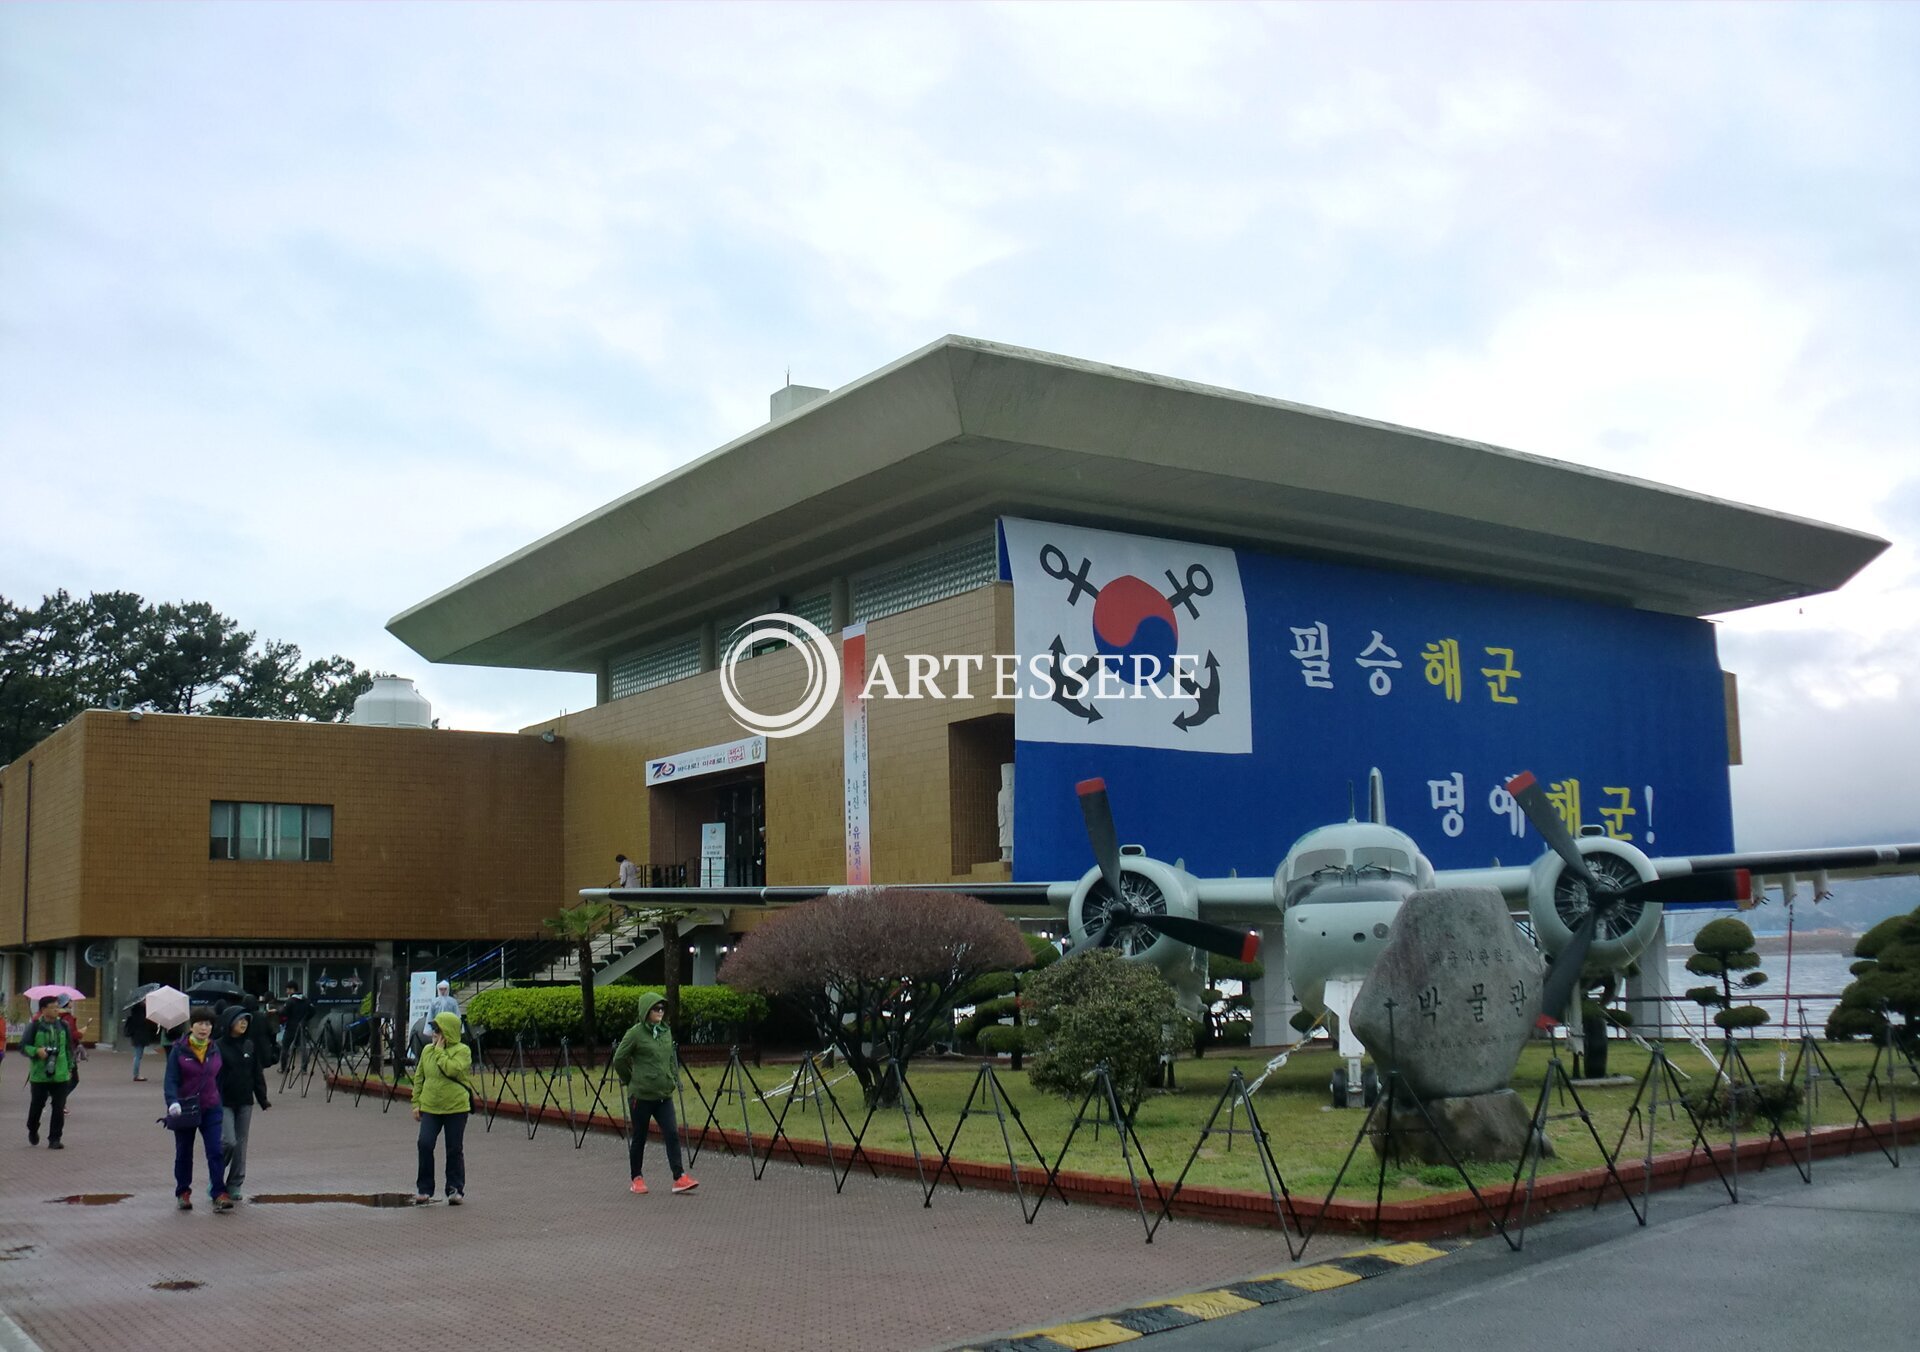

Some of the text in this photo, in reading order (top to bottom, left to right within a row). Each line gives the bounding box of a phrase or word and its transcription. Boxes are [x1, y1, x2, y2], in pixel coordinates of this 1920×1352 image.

[1289, 621, 1522, 704] 필승 해군
[652, 762, 676, 779] 70
[1427, 771, 1526, 839] 명예
[1418, 980, 1528, 1025] 박물관
